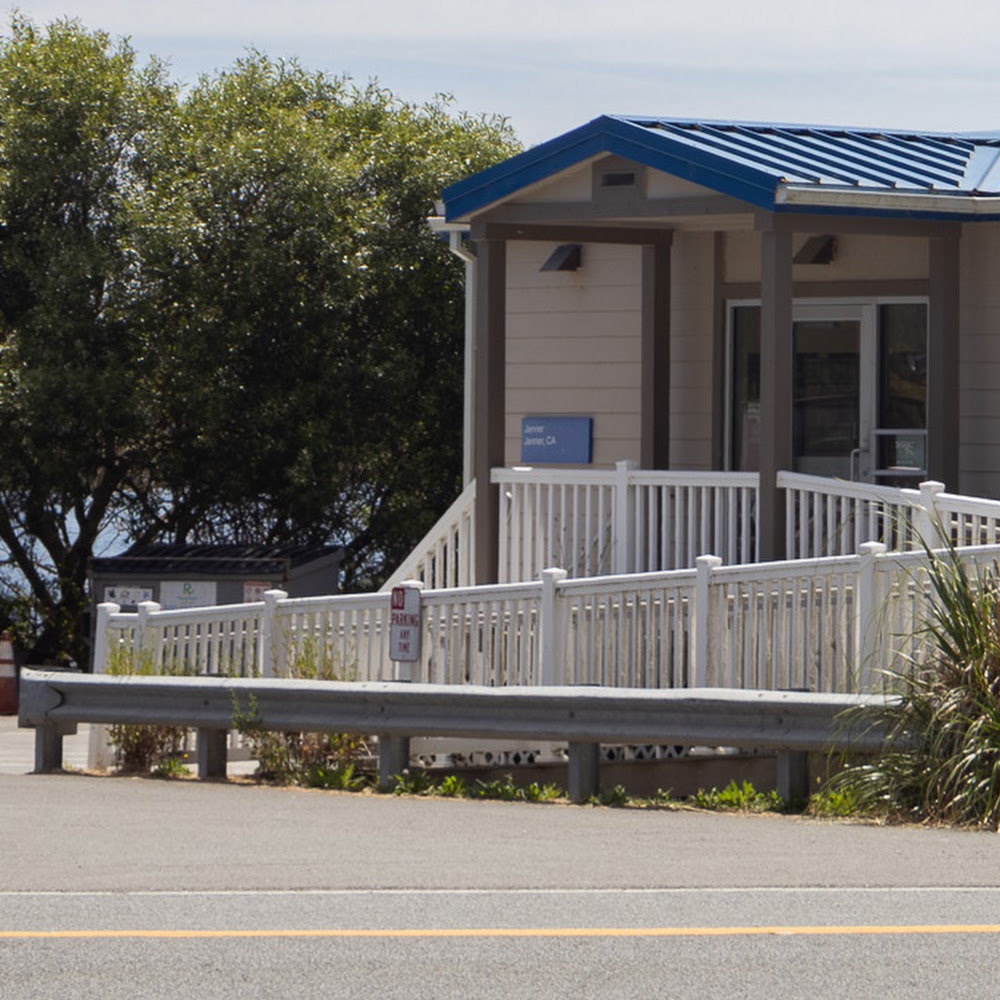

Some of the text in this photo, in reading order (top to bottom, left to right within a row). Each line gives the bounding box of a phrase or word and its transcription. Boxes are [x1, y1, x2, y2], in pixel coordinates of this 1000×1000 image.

[524, 425, 544, 434] Jenner
[546, 436, 556, 446] CA
[392, 588, 403, 607] NO
[391, 612, 419, 627] PARKING
[400, 630, 409, 640] ANY
[398, 642, 410, 653] TIME
